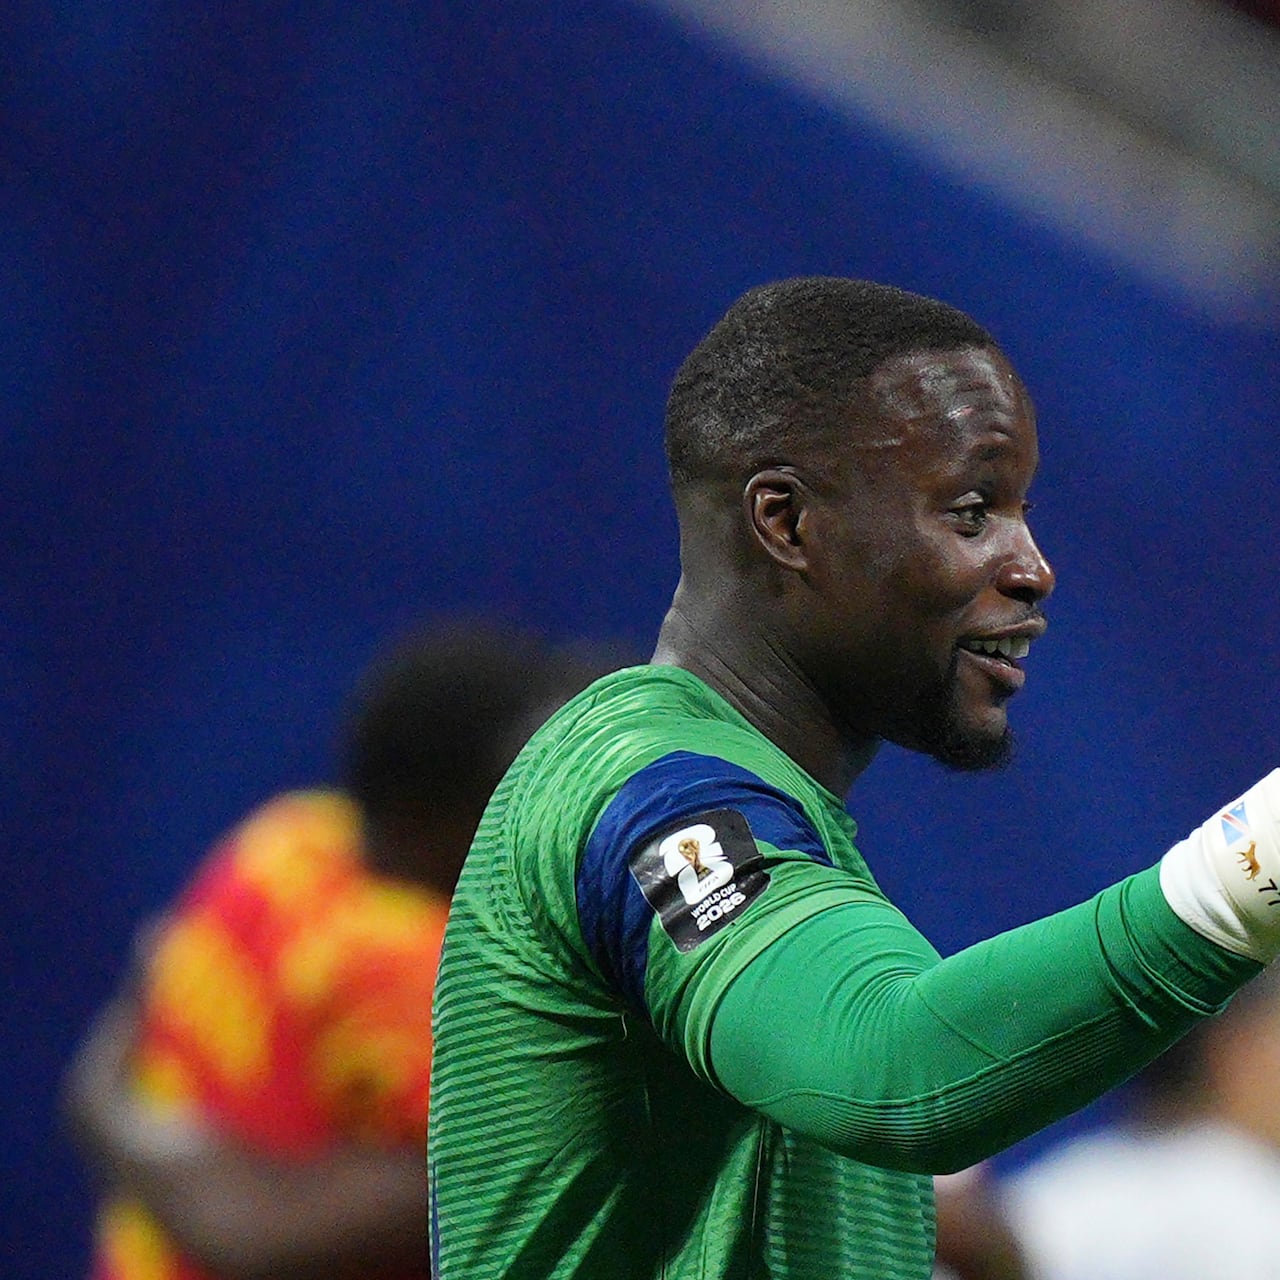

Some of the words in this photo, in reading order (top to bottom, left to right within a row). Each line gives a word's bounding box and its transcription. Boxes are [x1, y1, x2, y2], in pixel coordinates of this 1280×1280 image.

[690, 892, 722, 919] WORLD
[720, 882, 737, 898] CUP
[696, 891, 747, 932] 2026
